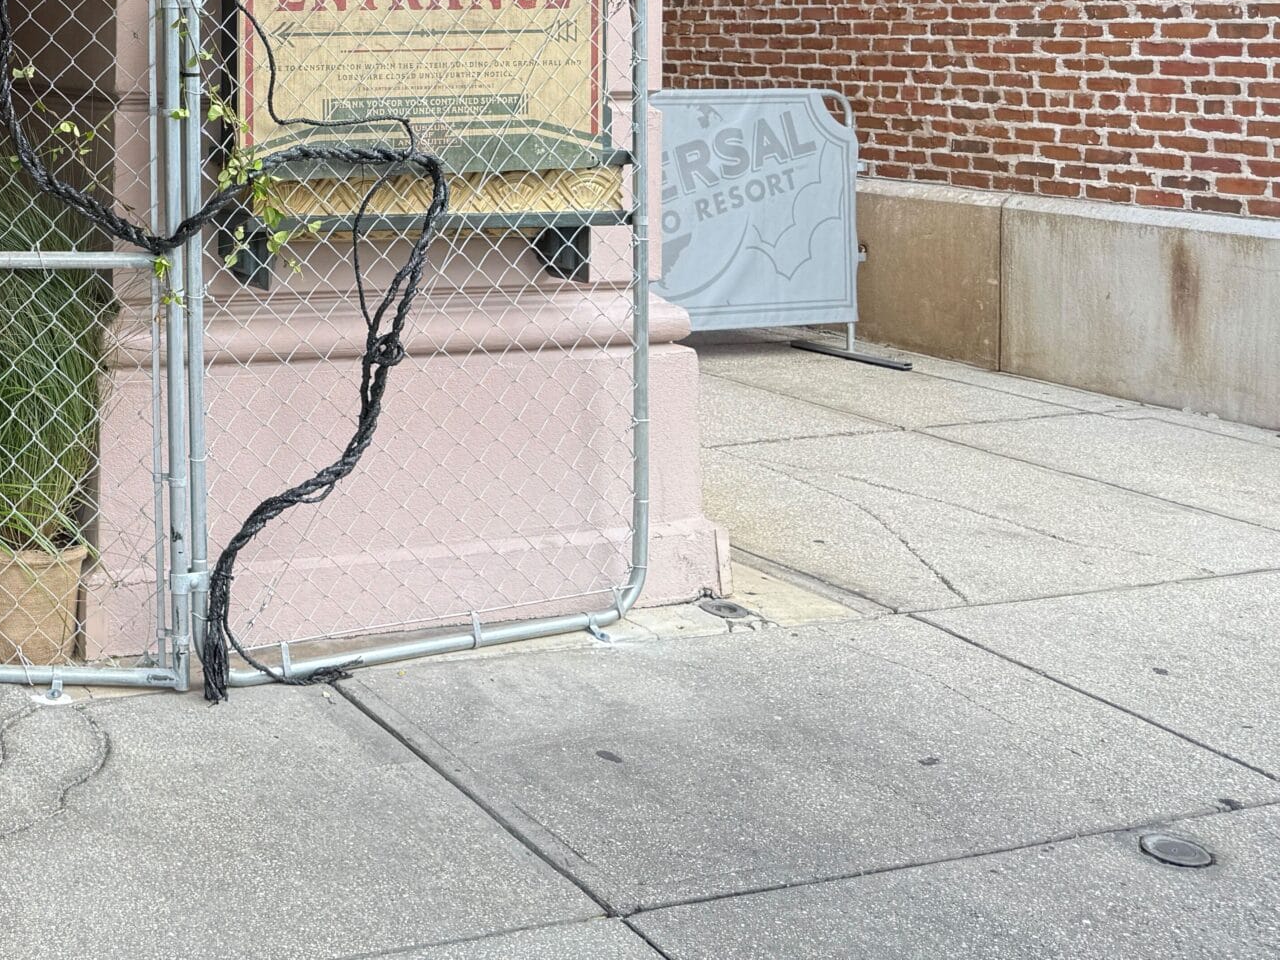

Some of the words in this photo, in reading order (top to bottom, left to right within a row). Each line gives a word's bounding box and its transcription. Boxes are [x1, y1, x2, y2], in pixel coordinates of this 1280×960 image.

[399, 62, 415, 70] THE
[367, 100, 384, 108] YOU
[386, 99, 403, 108] FOR
[694, 169, 797, 223] RESORT
